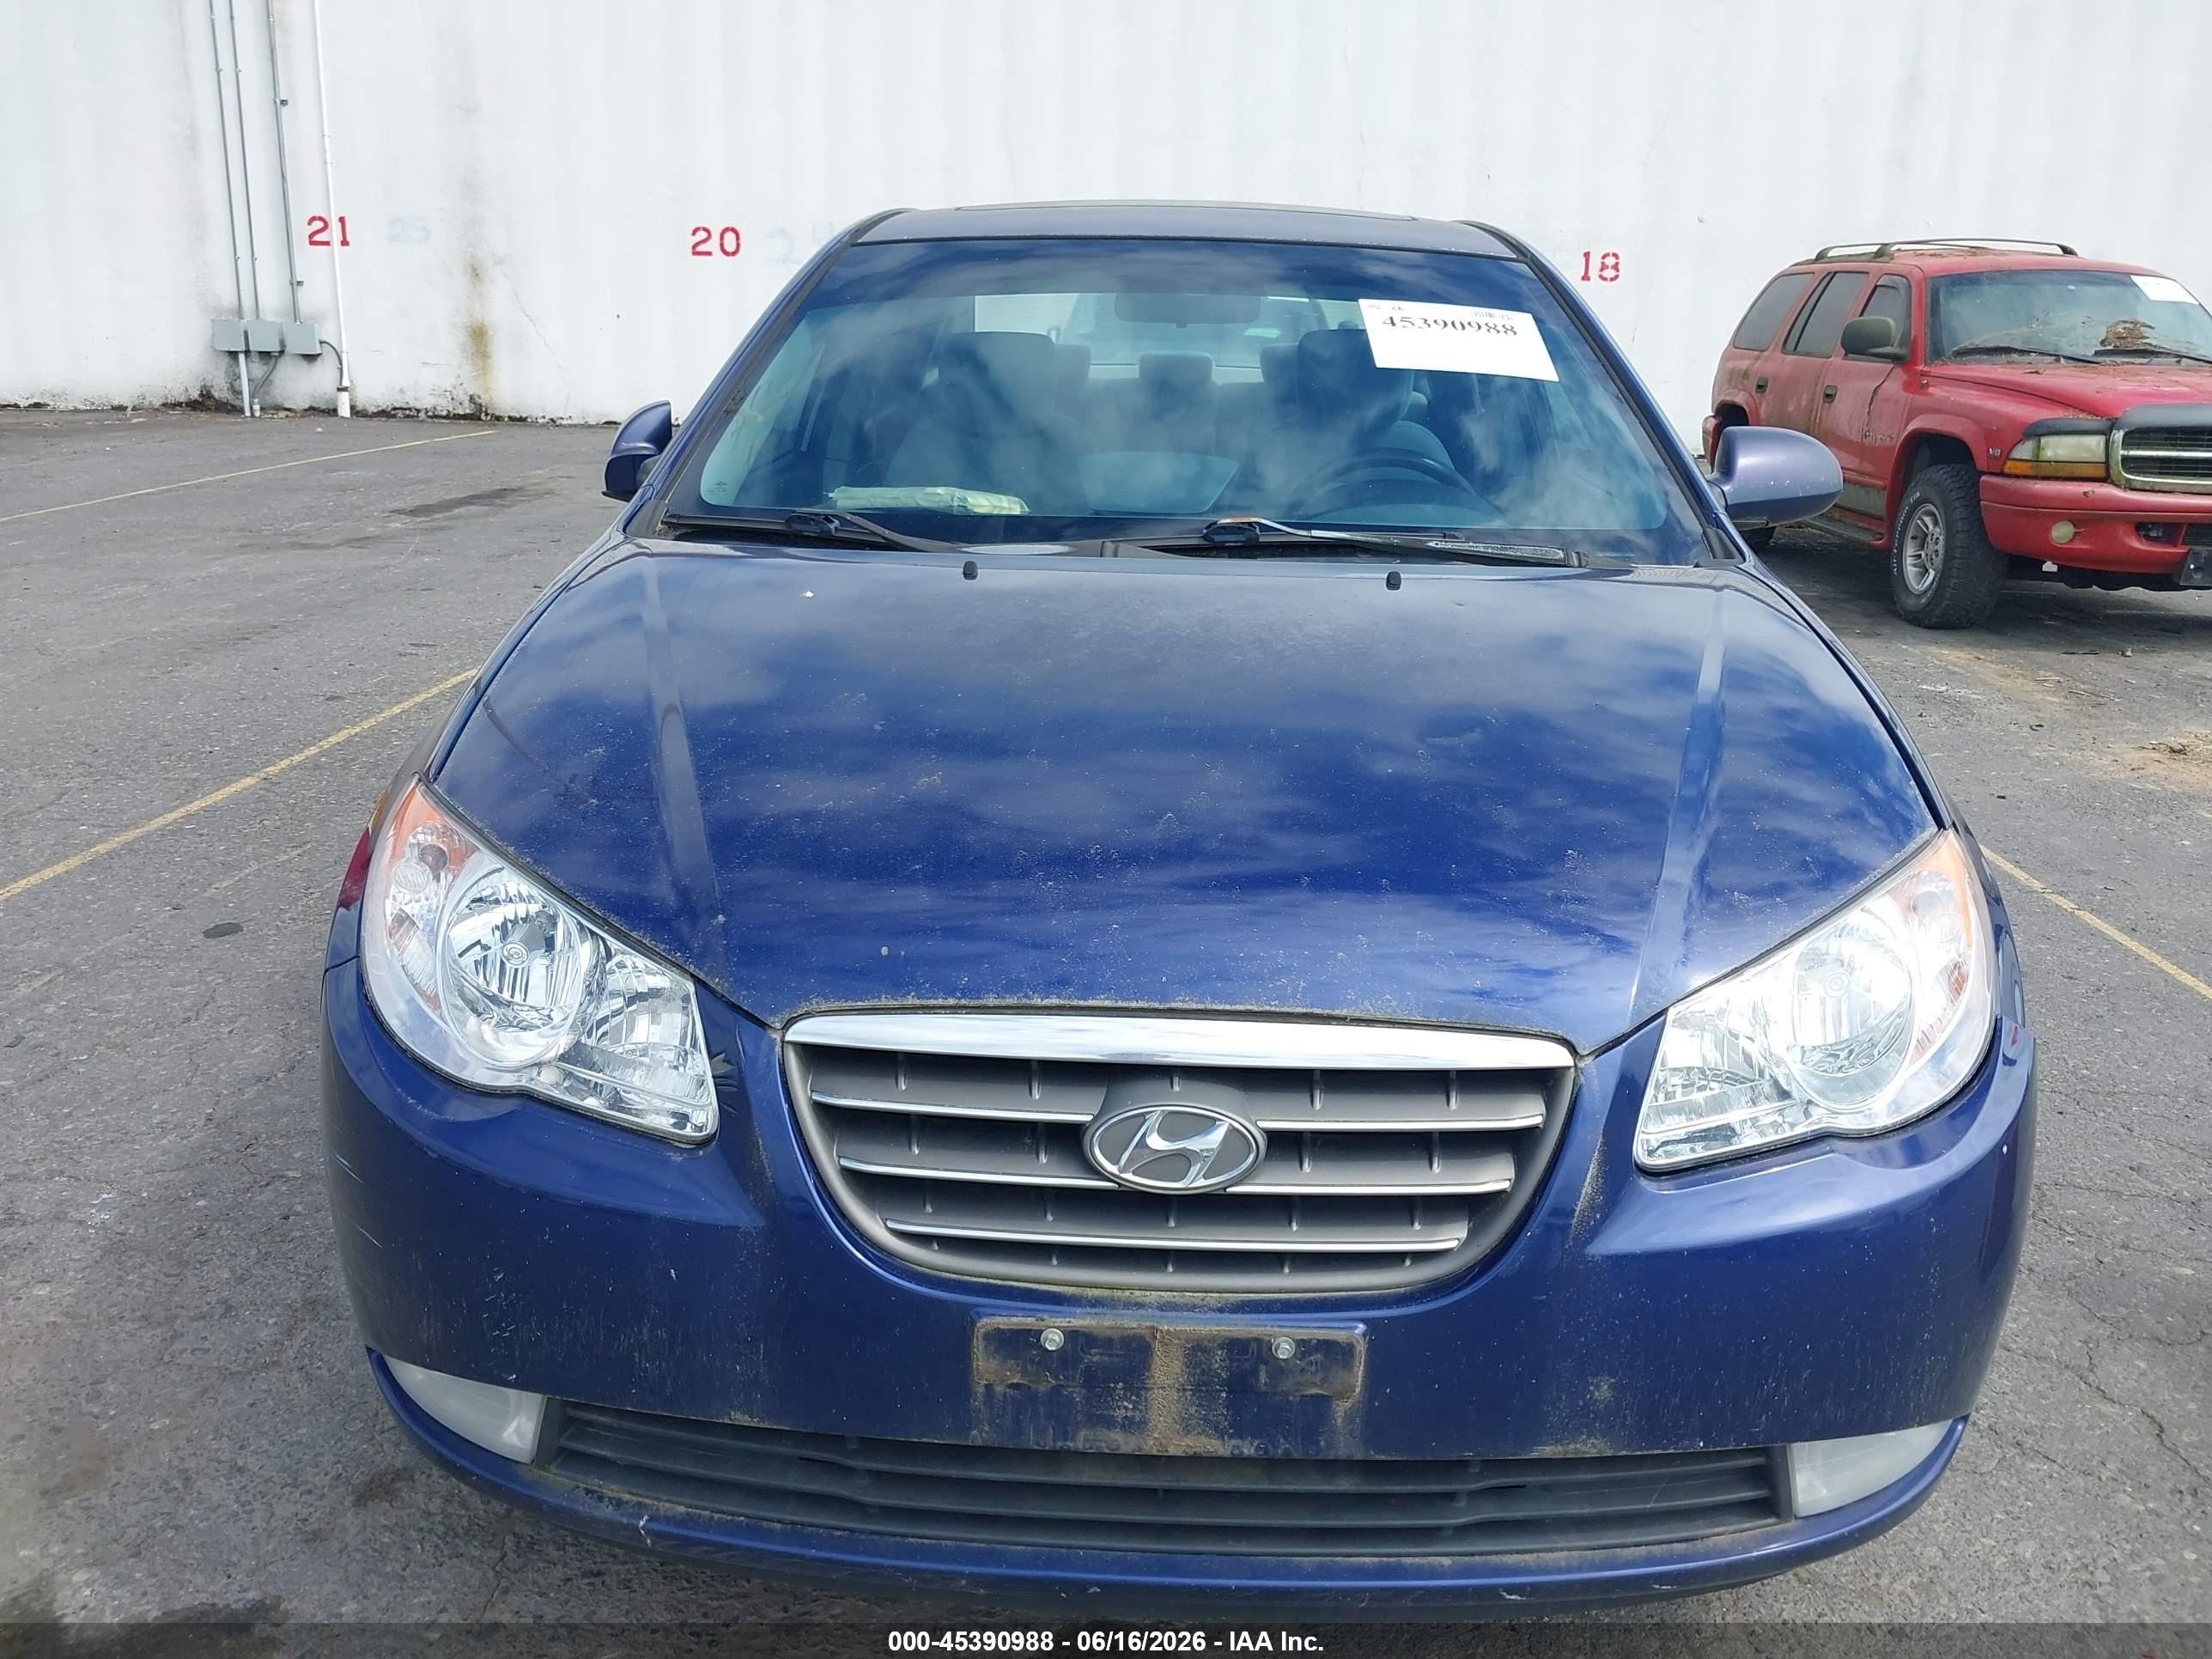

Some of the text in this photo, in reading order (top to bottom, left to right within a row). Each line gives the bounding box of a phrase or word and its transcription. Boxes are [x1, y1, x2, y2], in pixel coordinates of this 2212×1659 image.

[307, 215, 349, 247] 21
[690, 225, 741, 258] 20
[1580, 251, 1620, 283] 18
[1382, 314, 1518, 337] 45390988
